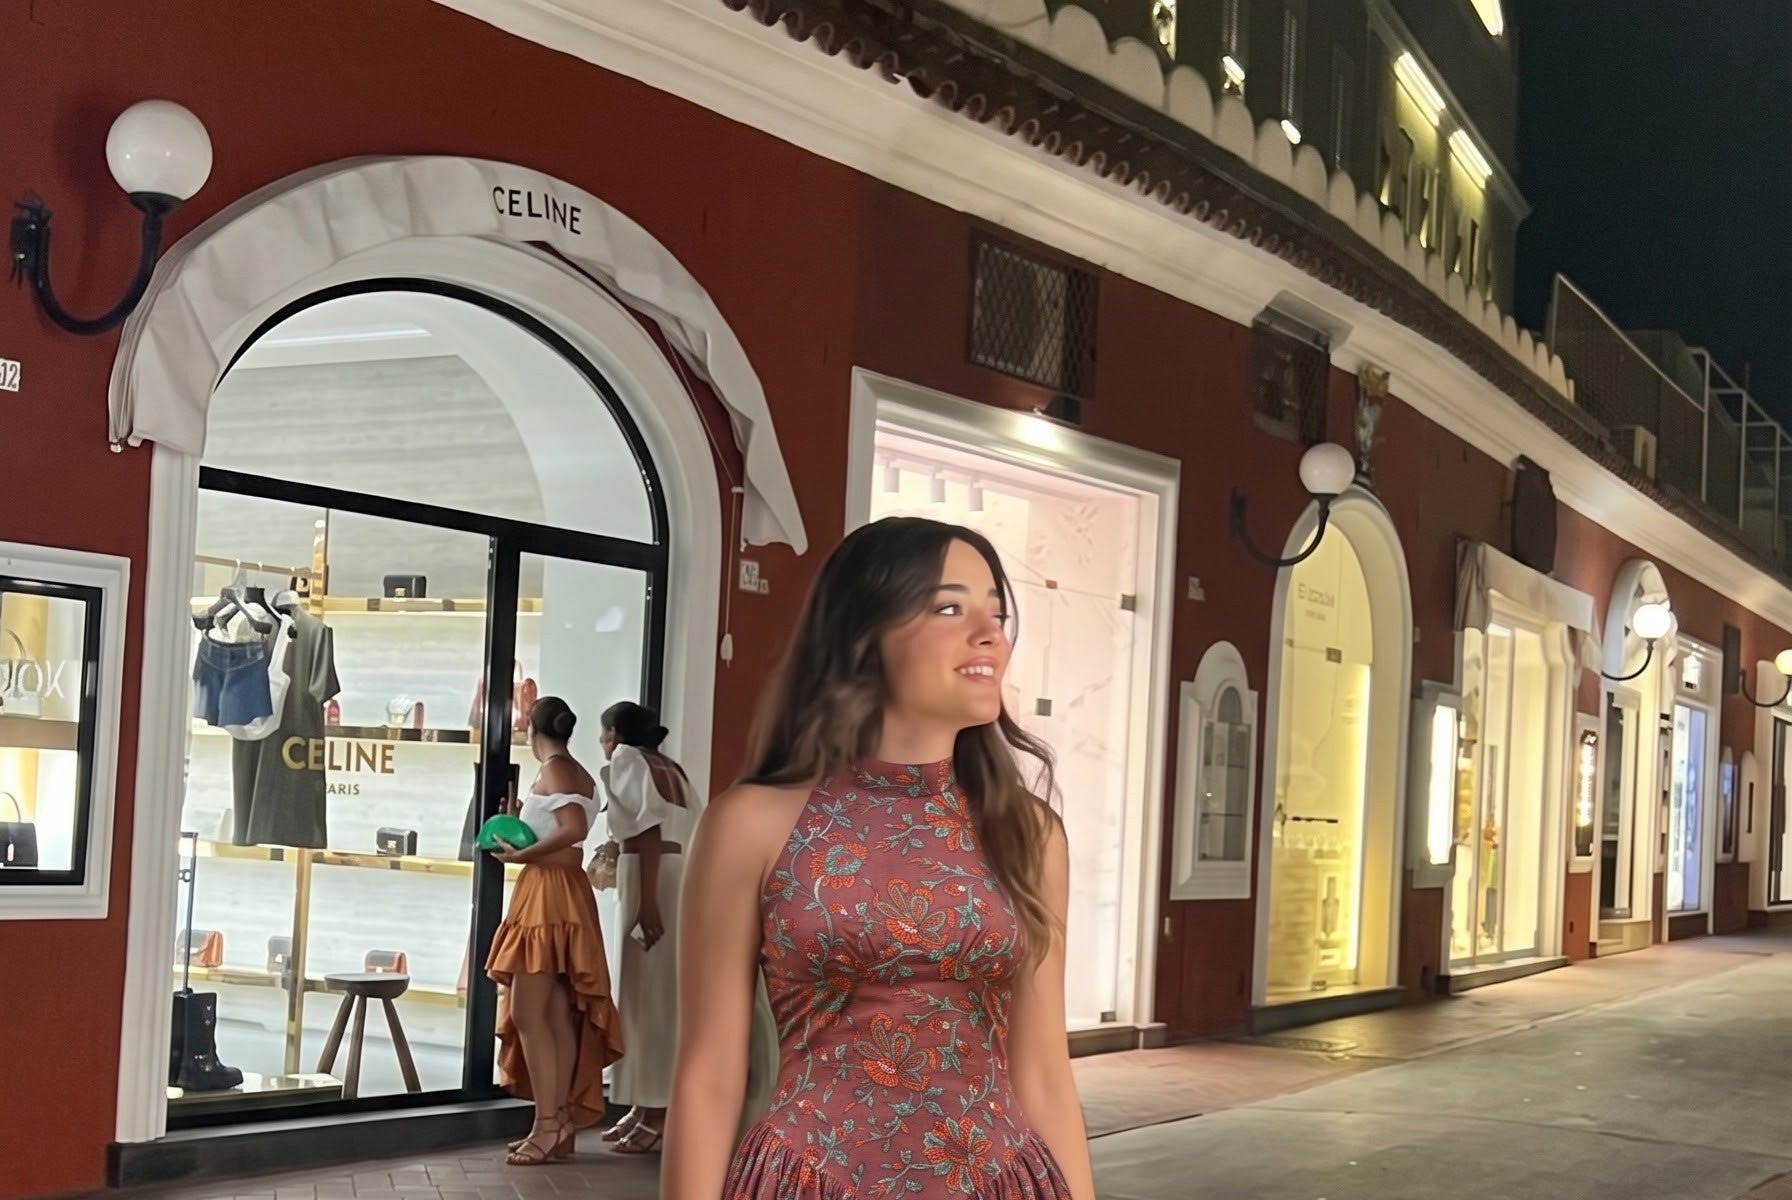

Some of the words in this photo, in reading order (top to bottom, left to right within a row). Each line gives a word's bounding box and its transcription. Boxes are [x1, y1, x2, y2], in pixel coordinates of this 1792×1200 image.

[492, 186, 582, 235] CELINE
[282, 736, 395, 774] CELINE
[323, 783, 361, 796] ARIS
